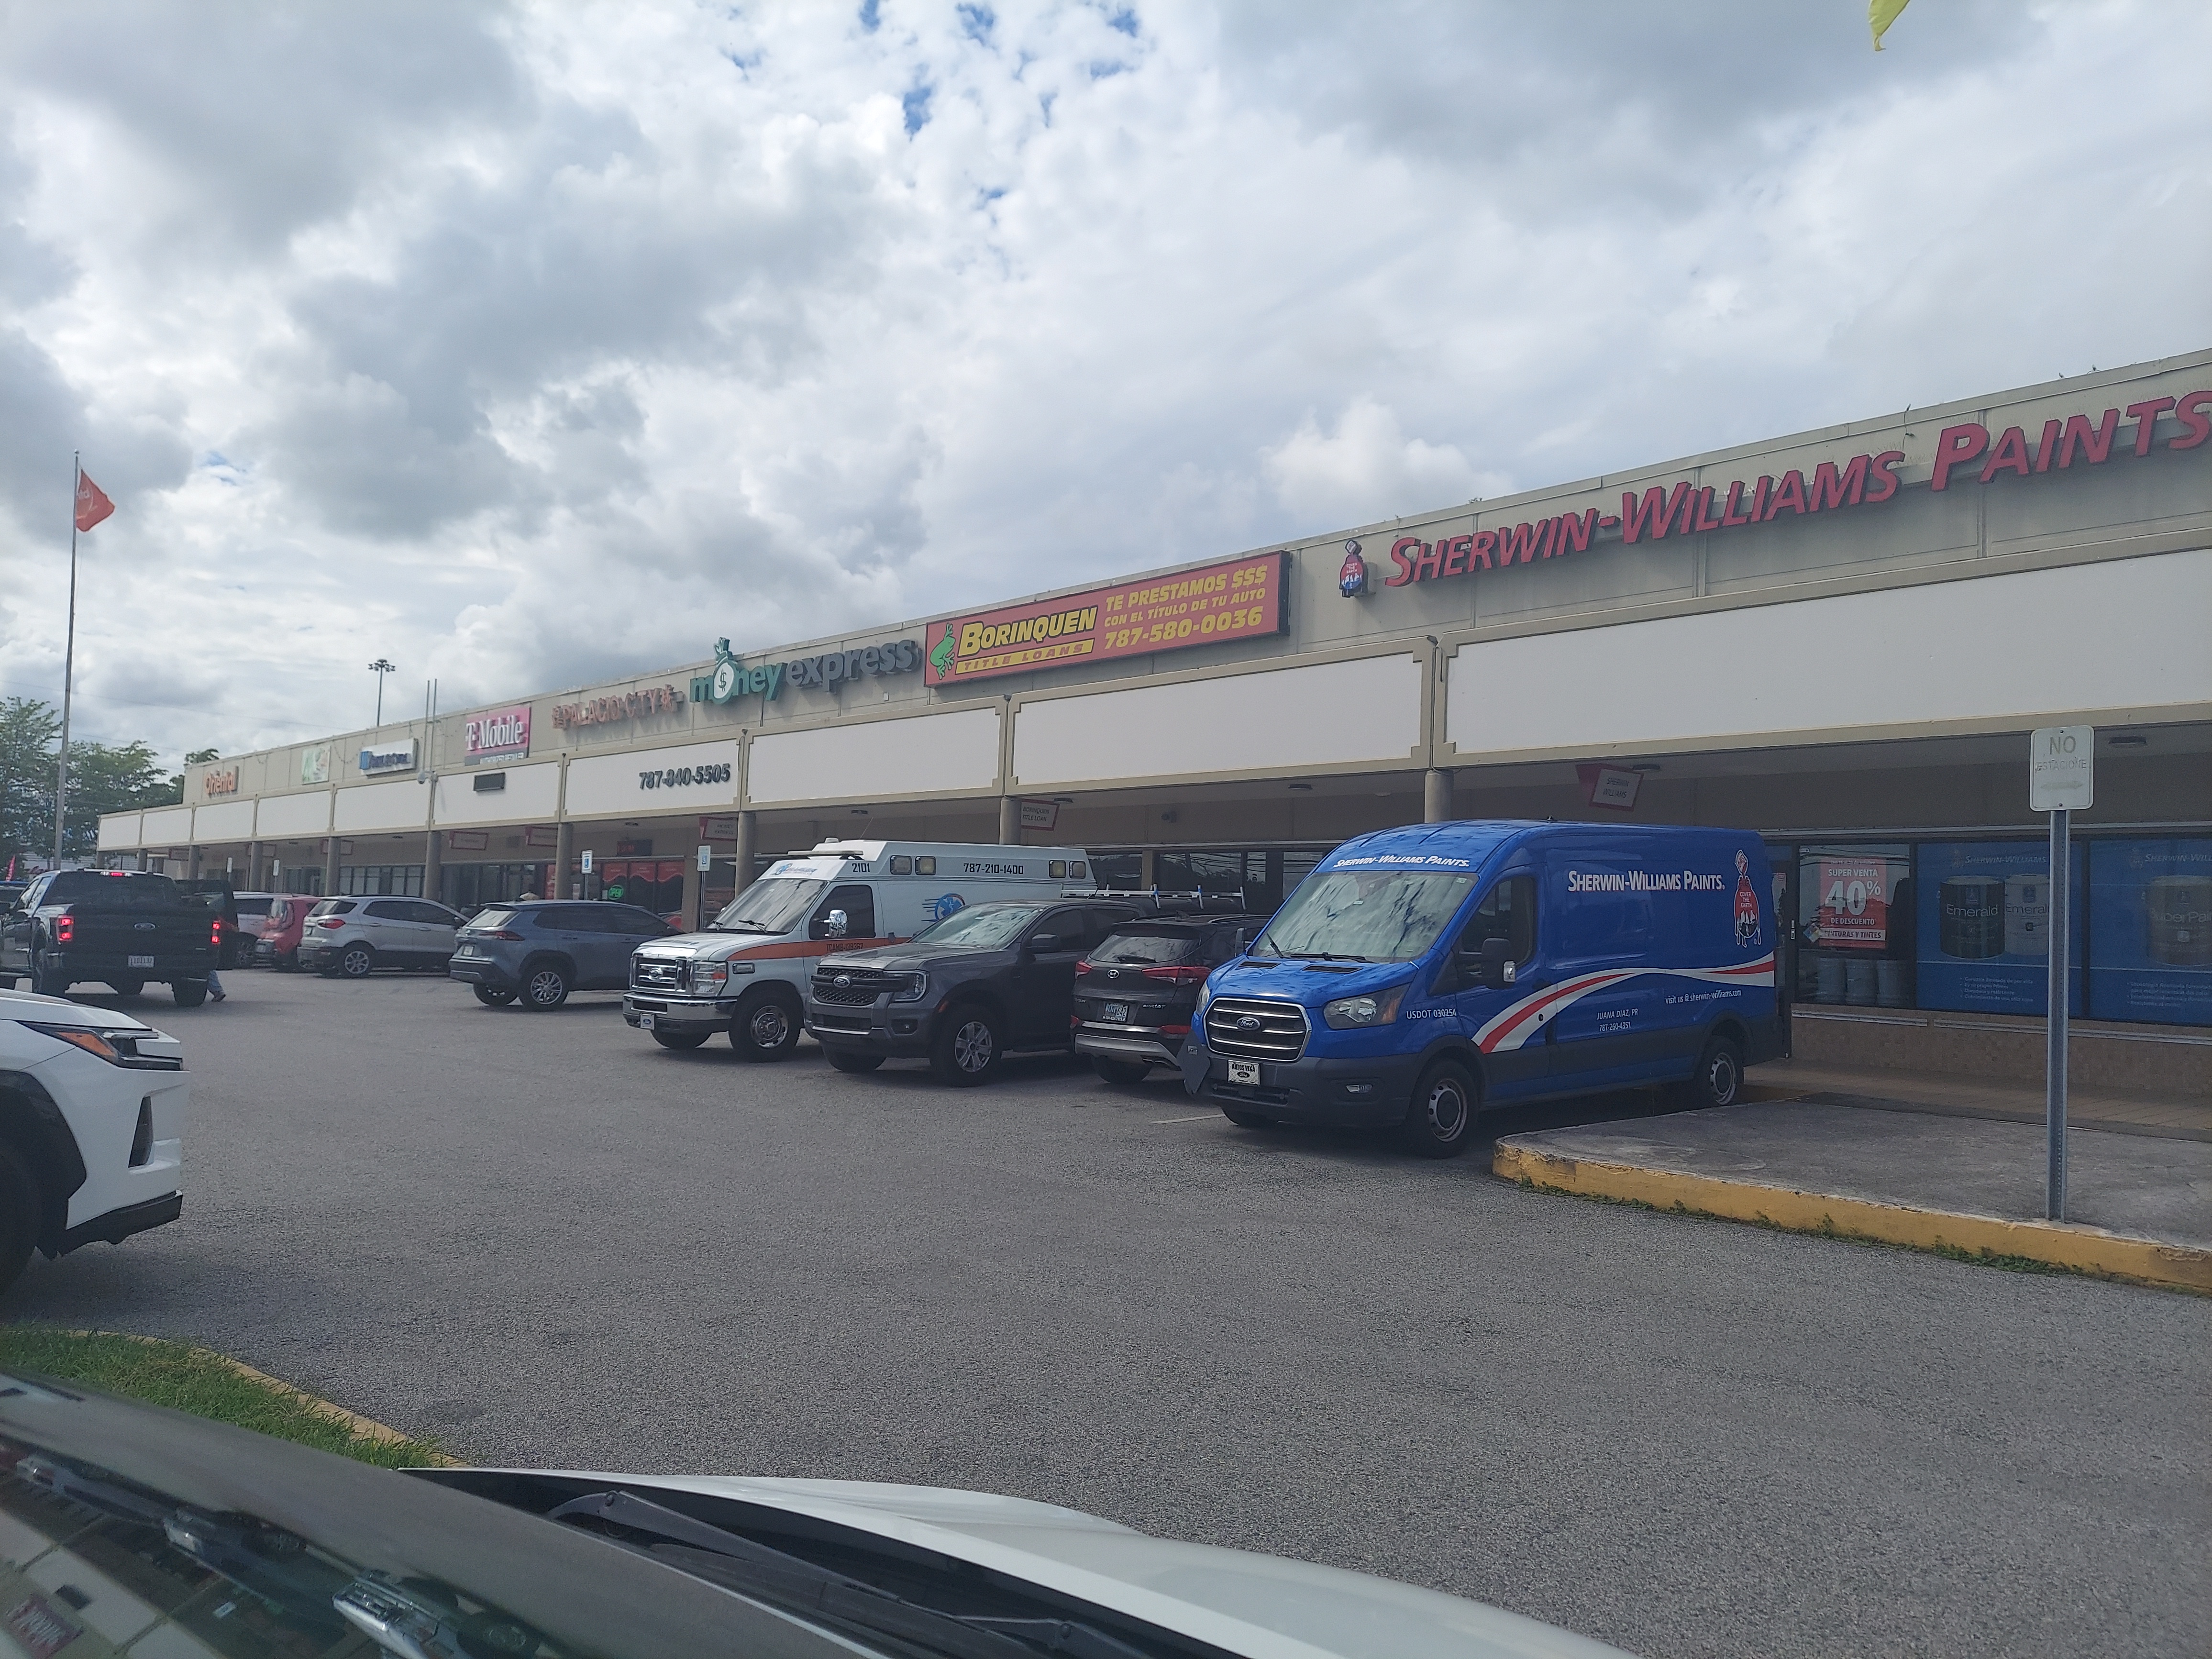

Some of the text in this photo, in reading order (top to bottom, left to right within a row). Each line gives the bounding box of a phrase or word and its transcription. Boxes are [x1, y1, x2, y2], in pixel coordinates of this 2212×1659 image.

[1385, 391, 2212, 587] SHERWIN-WILLIAMS PAINTS
[1106, 564, 1268, 612] TE PRESTAMOS $$$
[1104, 587, 1266, 627] CON EL TÍTULO DE TU AUTO
[957, 606, 1098, 658] BORINQUEN
[1105, 606, 1264, 650] 787-580-0036
[964, 643, 1084, 670] TITLE LOANS
[786, 640, 918, 693] express
[465, 715, 524, 751] T-Mobile
[2049, 735, 2076, 755] NO
[639, 763, 730, 790] 787-840-5505
[1023, 806, 1050, 814] BORINQUEN
[1333, 855, 1426, 867] SHERWIN-WILLIAMS
[1965, 855, 2047, 863] SHERWIN-WILLIAMS
[852, 863, 870, 873] 2101
[963, 863, 1024, 874] 787-210-1400
[1828, 869, 1878, 877] SUPER VENTA
[1568, 870, 1681, 892] SHERWIN-WILLIAMS
[1946, 903, 1998, 917] Emerald
[1665, 994, 1677, 1005] visit
[1685, 994, 1690, 1002] @
[1690, 989, 1742, 1002] sherwin-williams.com
[1117, 1007, 1127, 1017] 642
[1406, 1008, 1457, 1019] USDOT 030254
[1596, 1012, 1615, 1020] JUANA
[1632, 1008, 1638, 1016] PR
[1599, 1021, 1631, 1032] 787-260-4351
